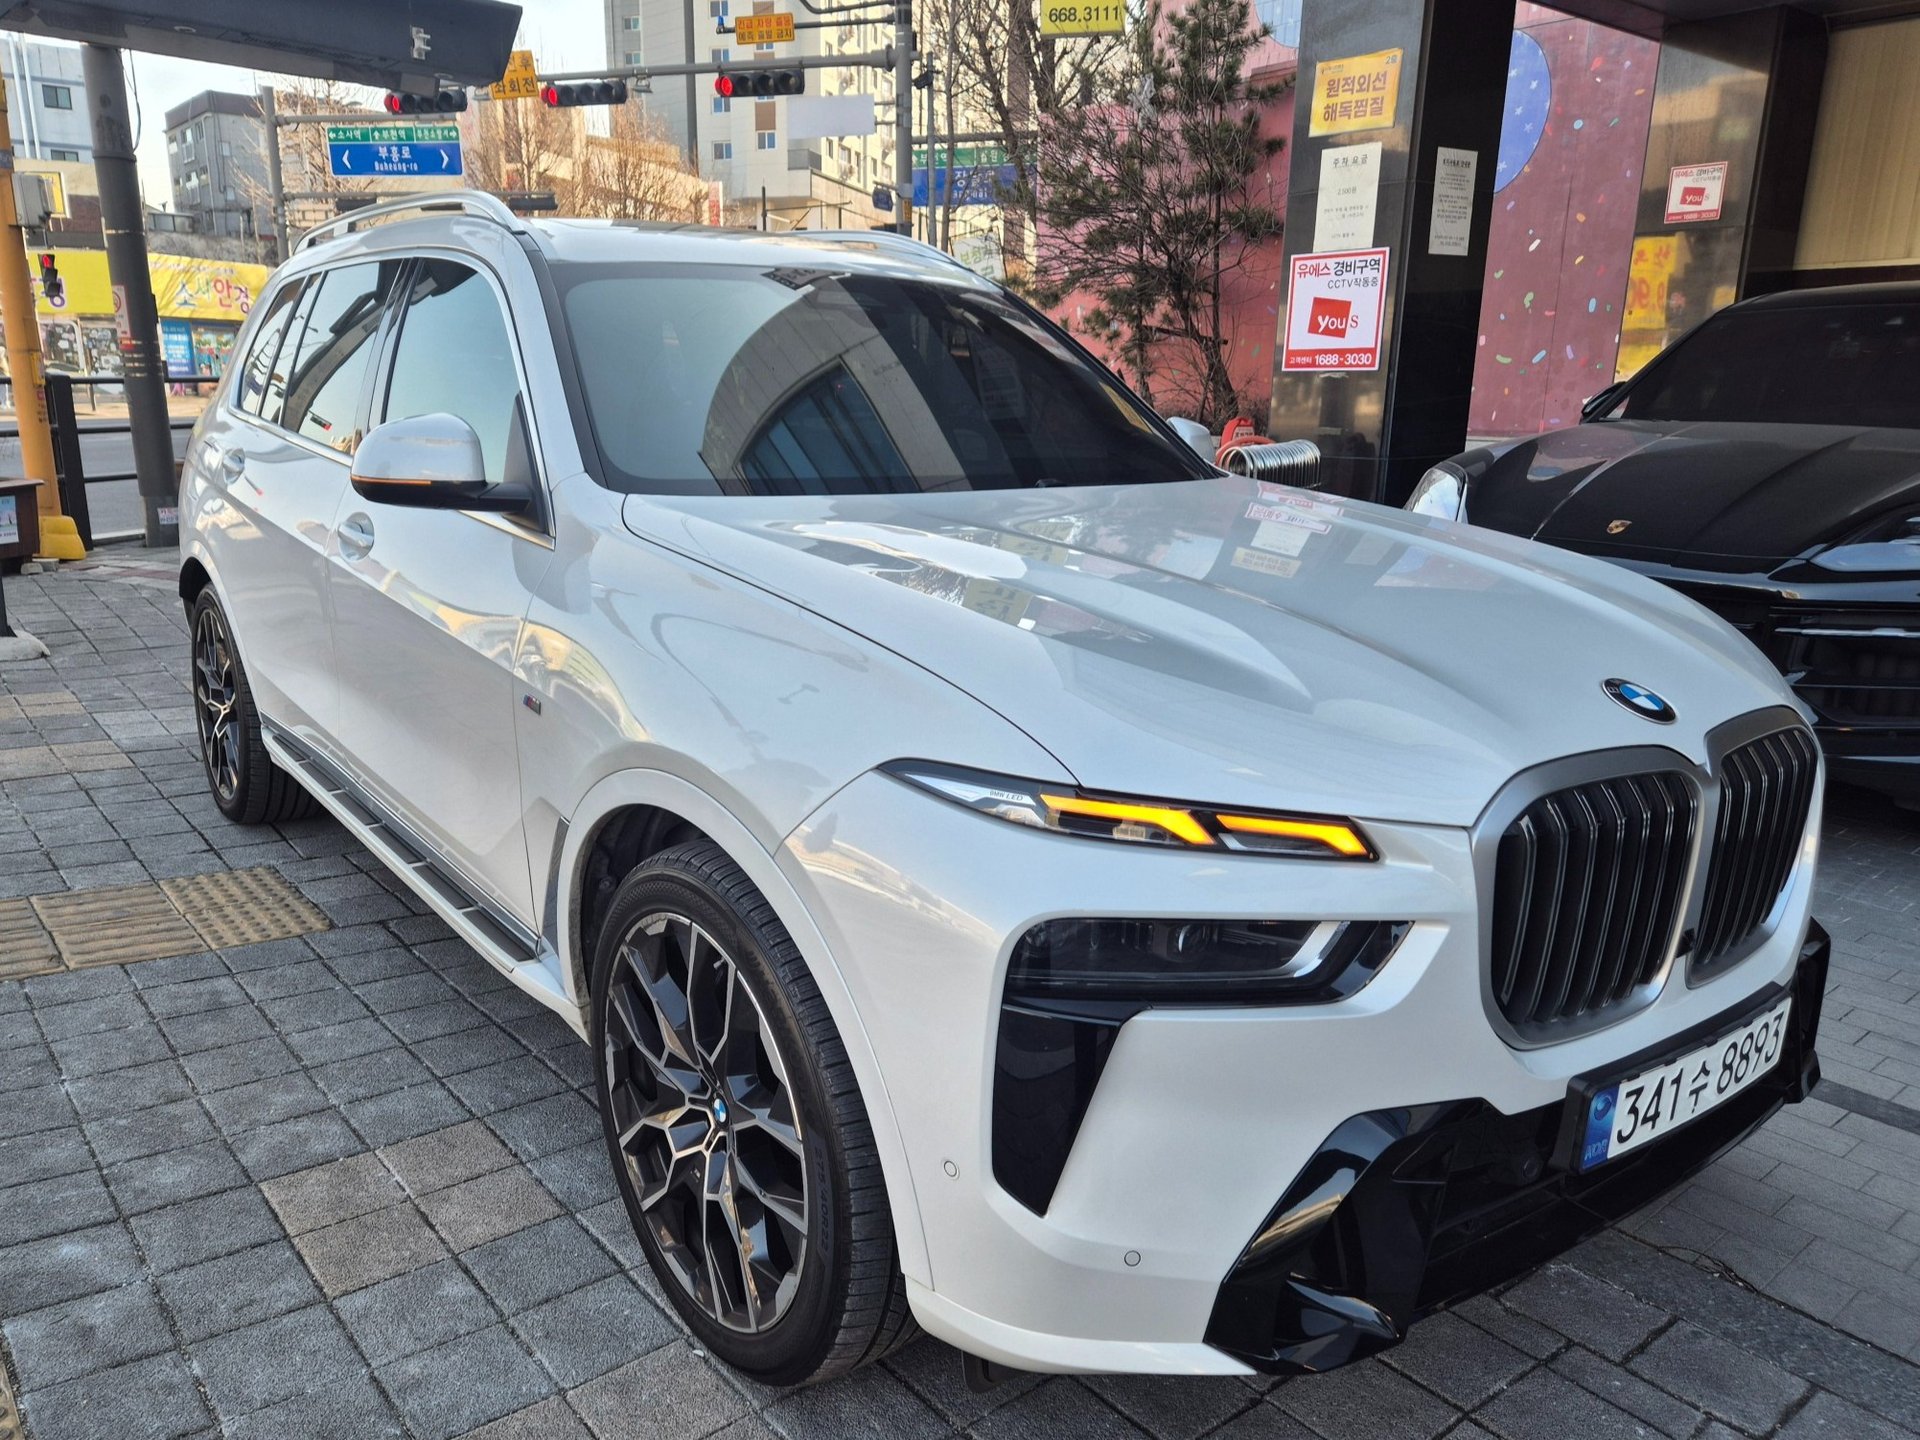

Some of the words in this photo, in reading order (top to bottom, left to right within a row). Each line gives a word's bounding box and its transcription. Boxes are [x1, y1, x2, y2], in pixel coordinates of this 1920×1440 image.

[1048, 5, 1119, 23] 668.3111
[494, 76, 536, 94] 좌회전
[1326, 71, 1388, 98] 원적외선
[1323, 96, 1384, 122] 해독찜질
[337, 129, 362, 141] 소사역
[378, 145, 412, 163] 부흥로
[1297, 262, 1331, 278] 유에스
[1333, 257, 1381, 277] 경비구역
[1327, 276, 1379, 290] CCTV작동중
[1315, 353, 1373, 366] 1688-3030
